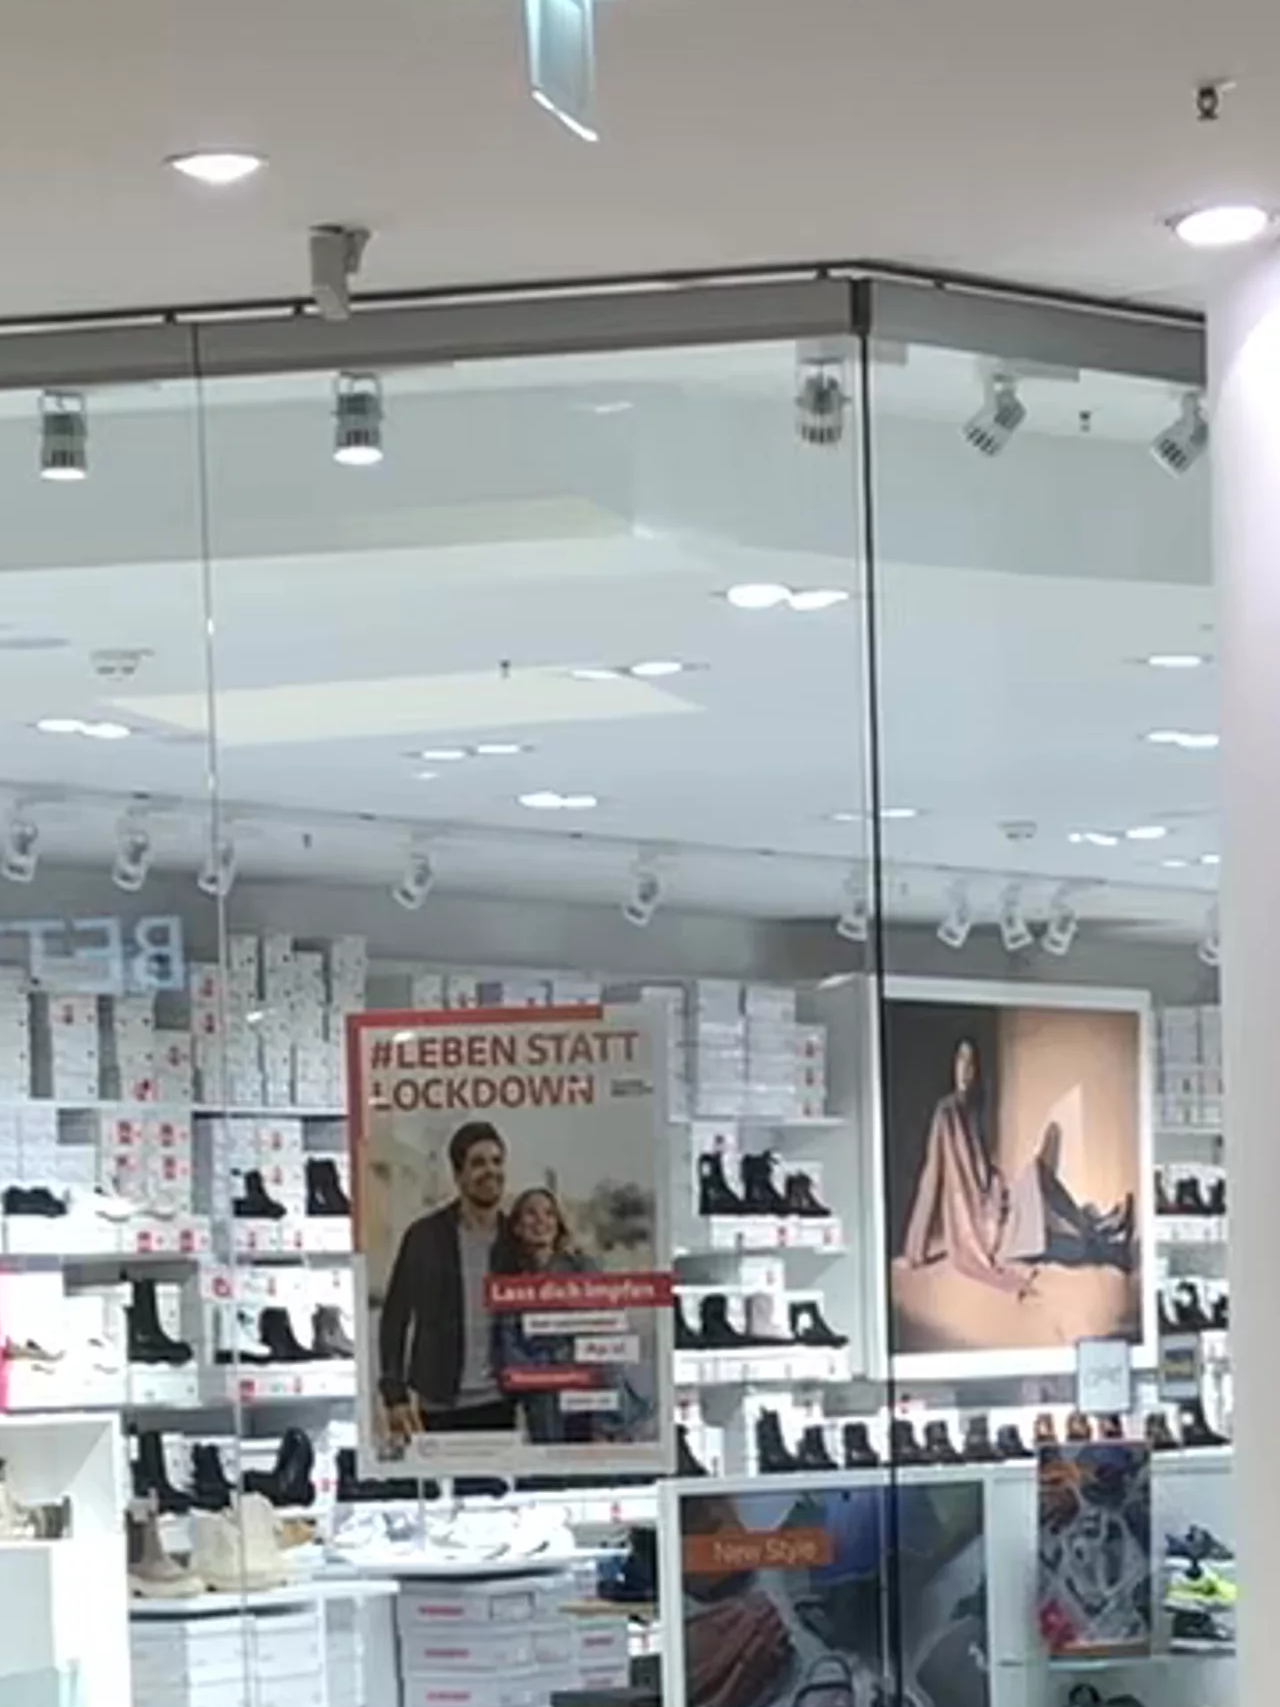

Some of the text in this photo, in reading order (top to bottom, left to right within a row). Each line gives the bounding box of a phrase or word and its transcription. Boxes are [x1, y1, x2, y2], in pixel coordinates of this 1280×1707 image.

[370, 1031, 640, 1070] #LEBEN STATT
[371, 1074, 595, 1111] LOCKDOWN
[712, 1538, 818, 1565] New Style
